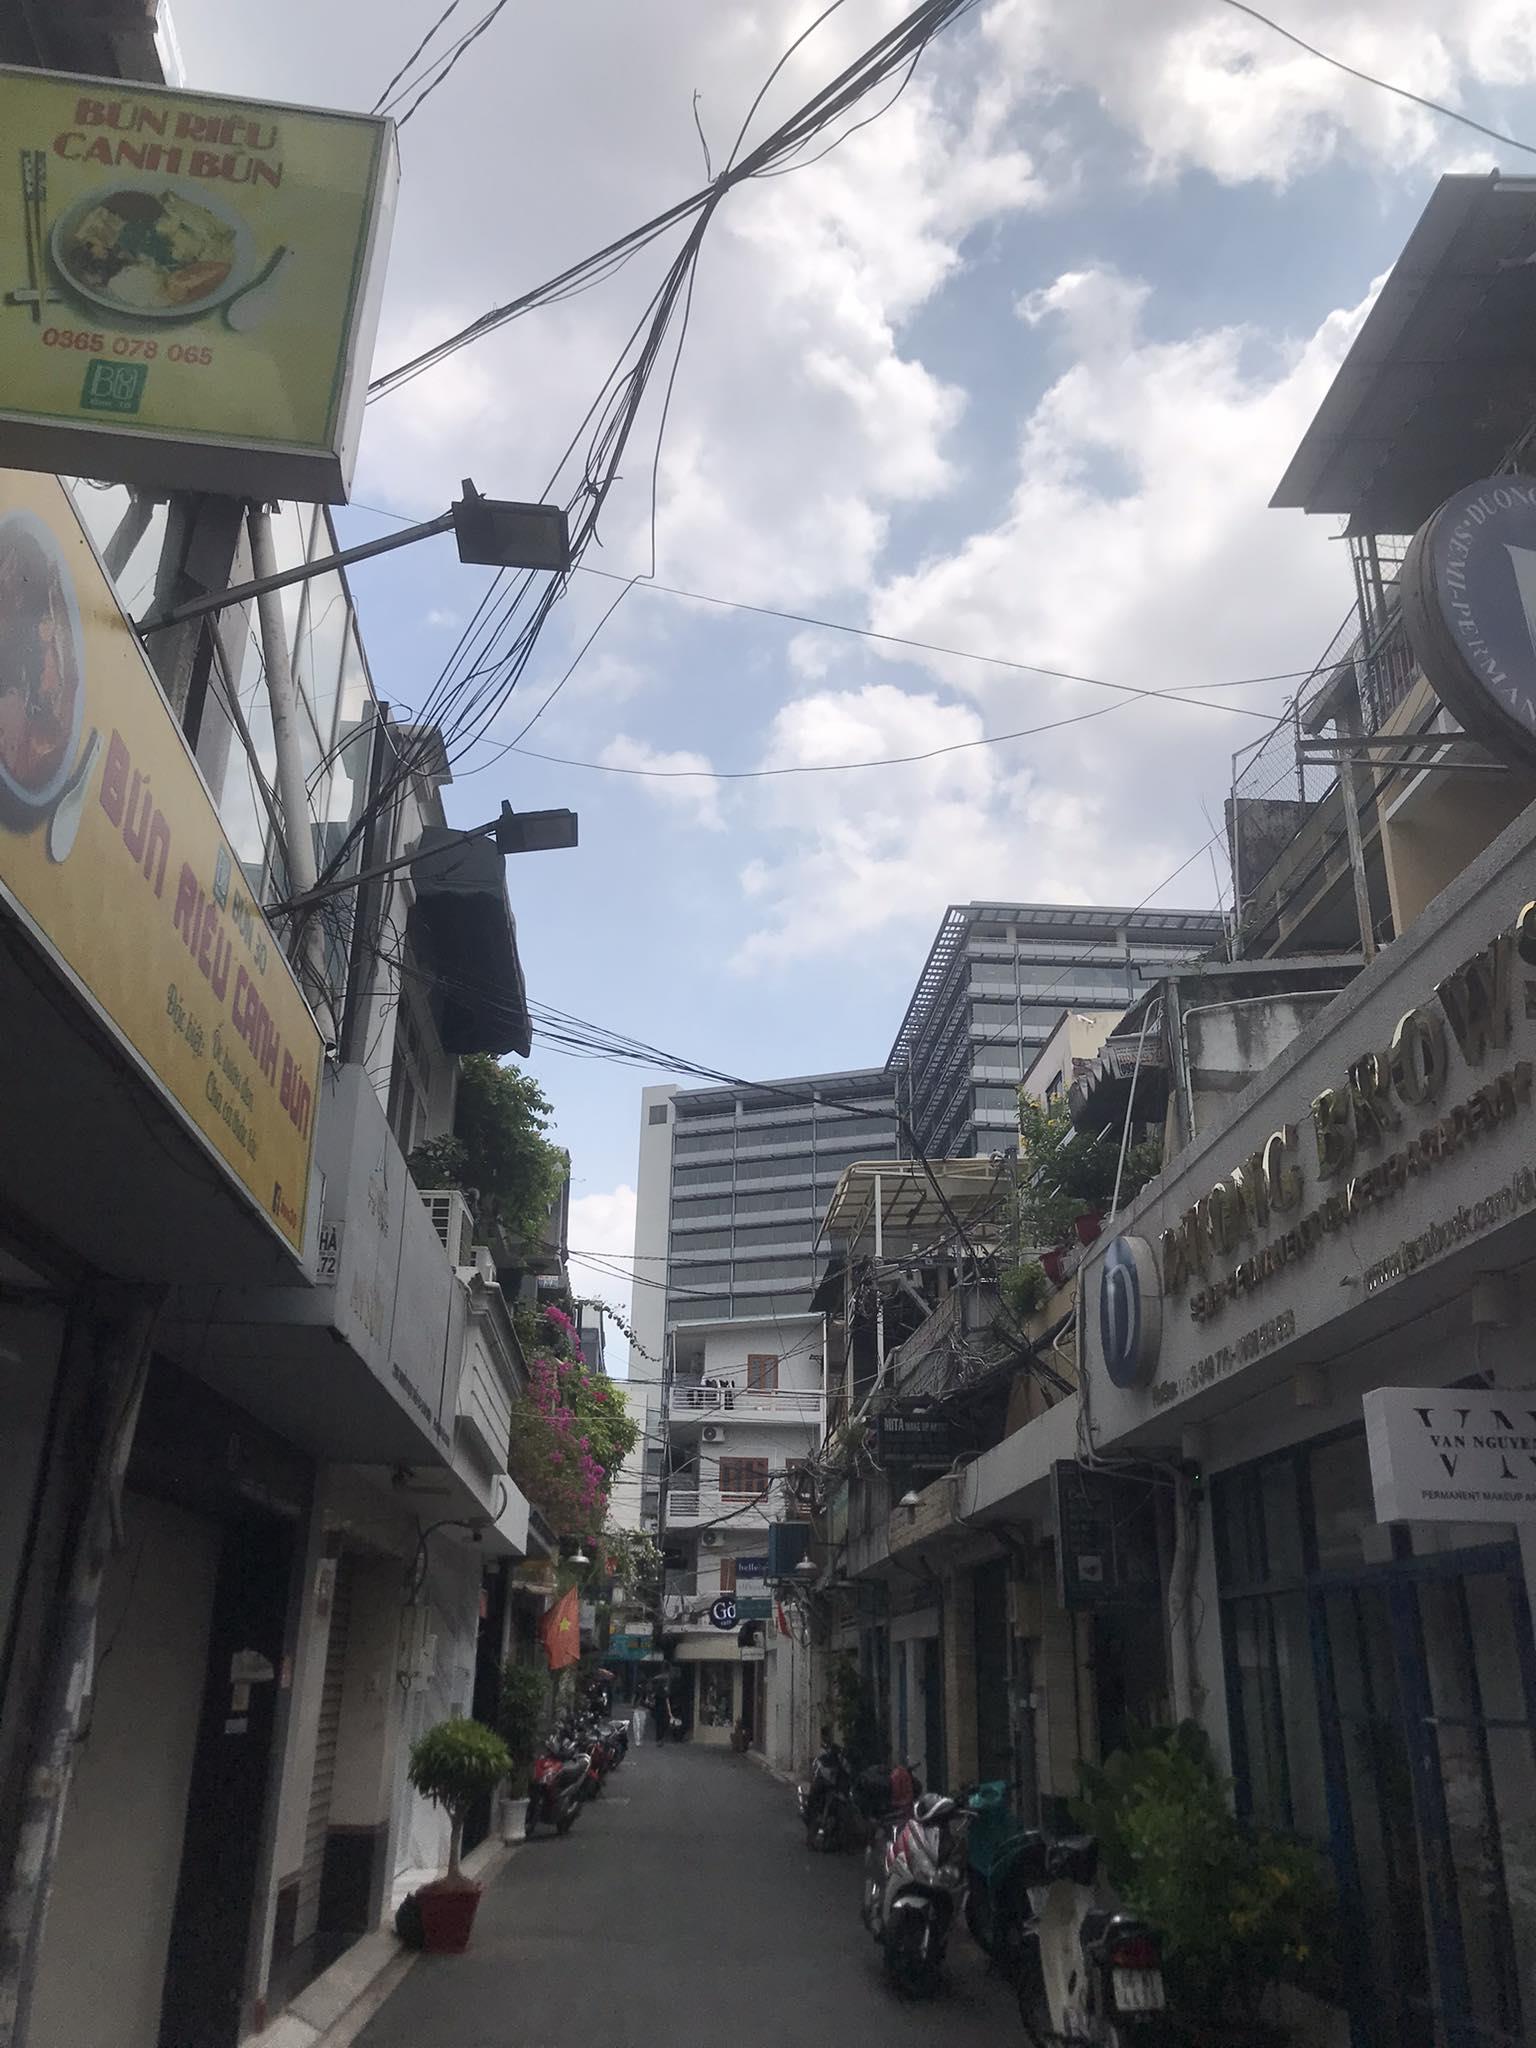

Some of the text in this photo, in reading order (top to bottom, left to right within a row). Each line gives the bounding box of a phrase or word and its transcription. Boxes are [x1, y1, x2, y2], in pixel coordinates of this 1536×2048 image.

[53, 131, 182, 175] CANH
[42, 327, 214, 366] 0365 078 065
[100, 728, 171, 899] BÚN
[232, 964, 280, 1088] CANH
[279, 1047, 312, 1141] BÚN
[1430, 1435, 1465, 1448] VAN
[1422, 1489, 1479, 1501] PERMANENT
[1483, 1491, 1522, 1502] MAKEUP
